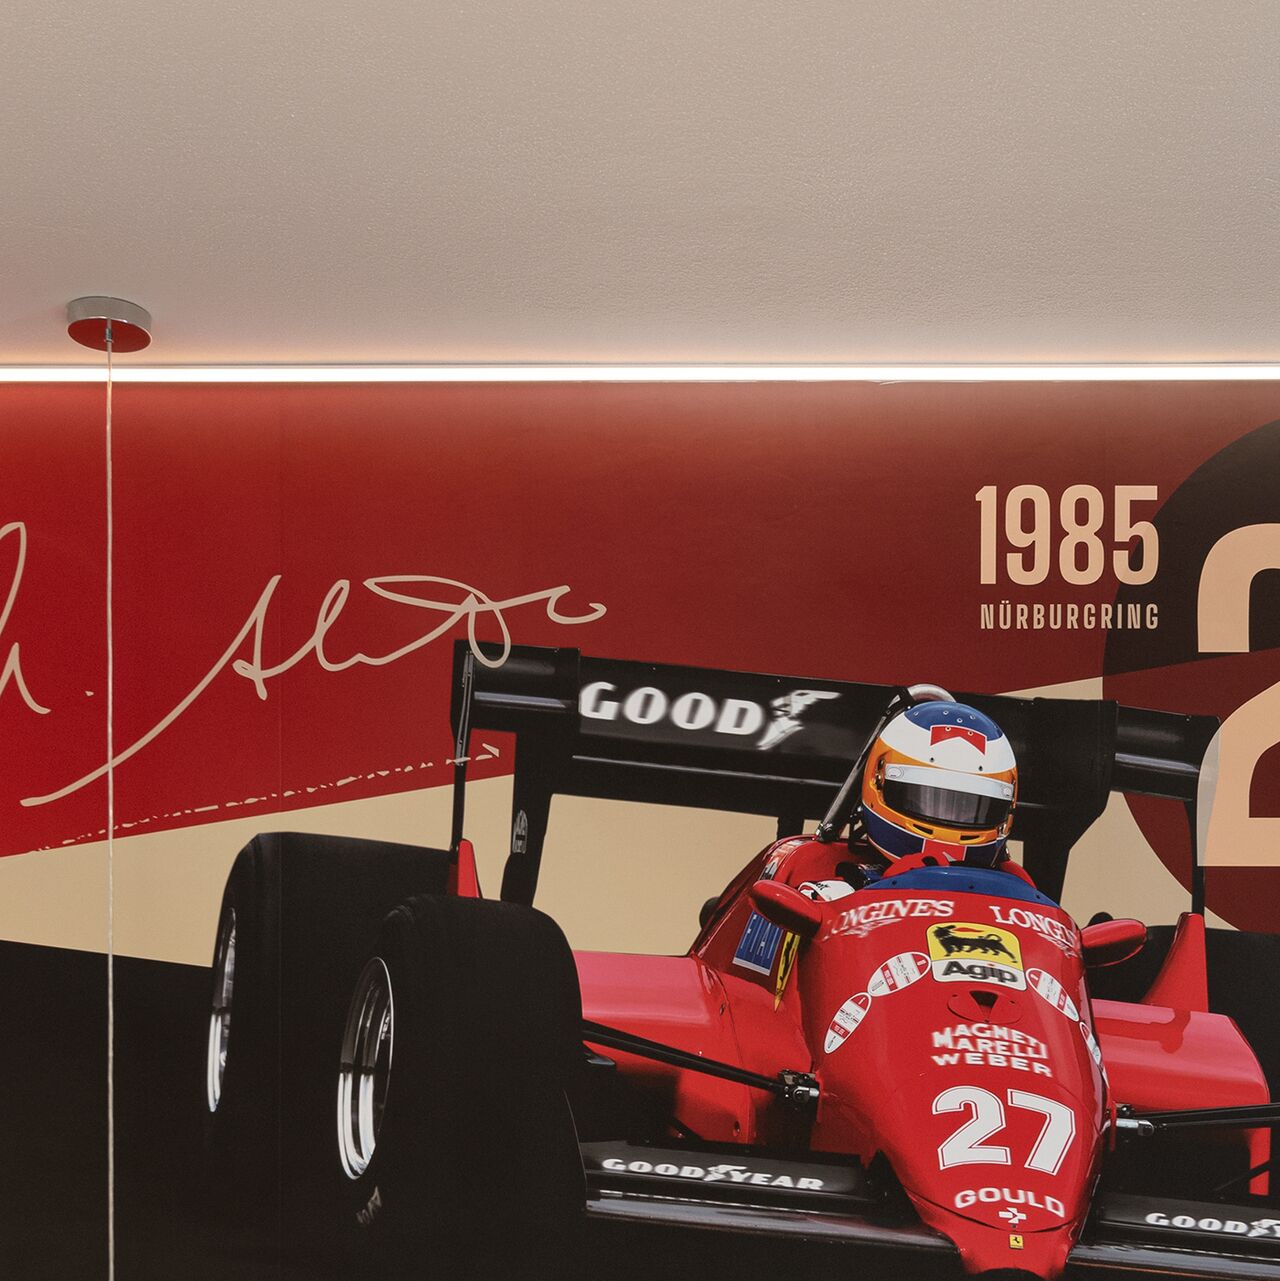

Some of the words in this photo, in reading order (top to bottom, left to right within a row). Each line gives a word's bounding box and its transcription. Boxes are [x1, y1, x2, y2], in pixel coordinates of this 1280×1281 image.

[975, 484, 1159, 586] 1985
[980, 600, 1159, 630] NÜRBURGRING
[578, 681, 764, 736] GOOD
[942, 961, 1018, 983] Agip
[931, 1052, 1053, 1078] WEBER
[932, 1085, 1076, 1176] 27
[954, 1187, 1065, 1218] GOULD
